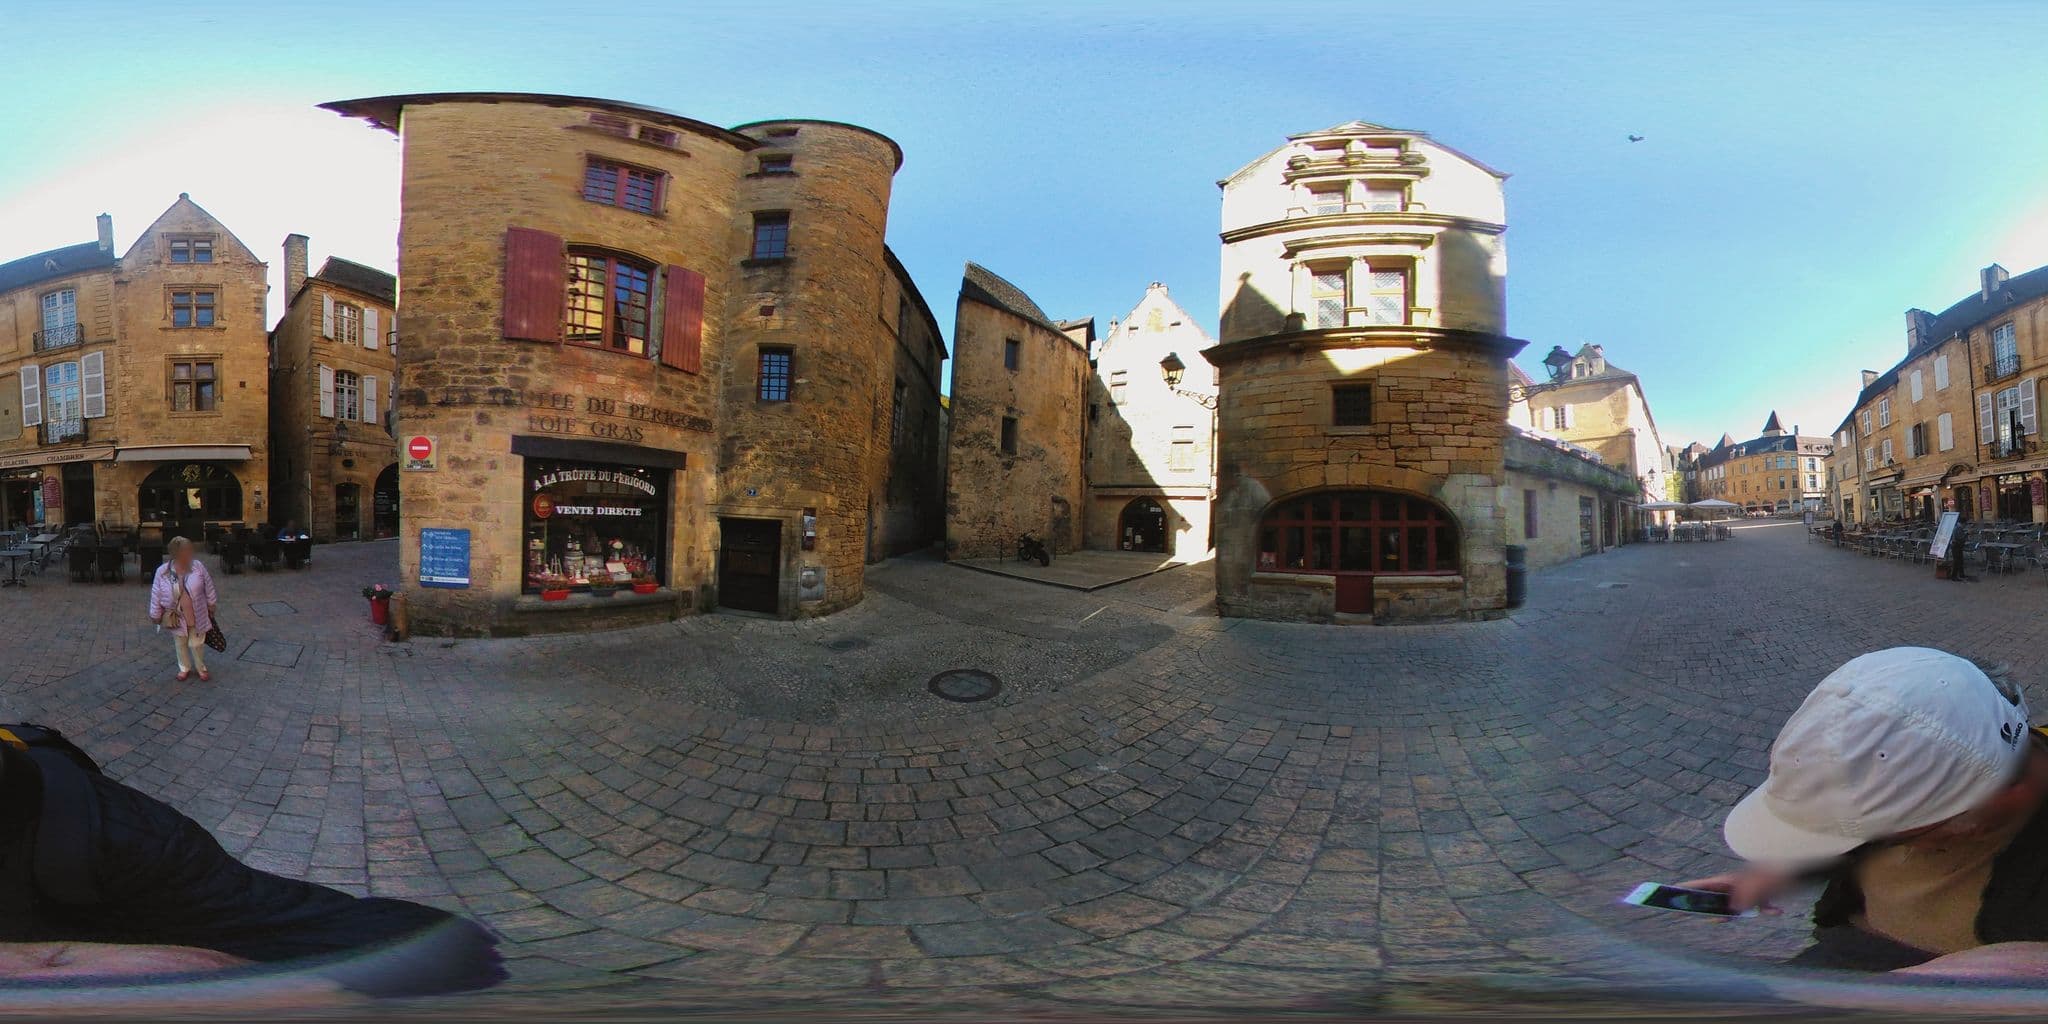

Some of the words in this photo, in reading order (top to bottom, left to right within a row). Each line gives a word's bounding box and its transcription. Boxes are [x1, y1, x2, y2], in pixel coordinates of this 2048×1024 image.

[586, 397, 615, 415] DU
[528, 414, 577, 432] FOIE
[591, 421, 644, 442] GRAS
[535, 480, 542, 491] A
[543, 474, 557, 485] LA
[599, 471, 612, 482] DU
[555, 506, 594, 515] VENTE
[597, 506, 642, 516] DIRECTE
